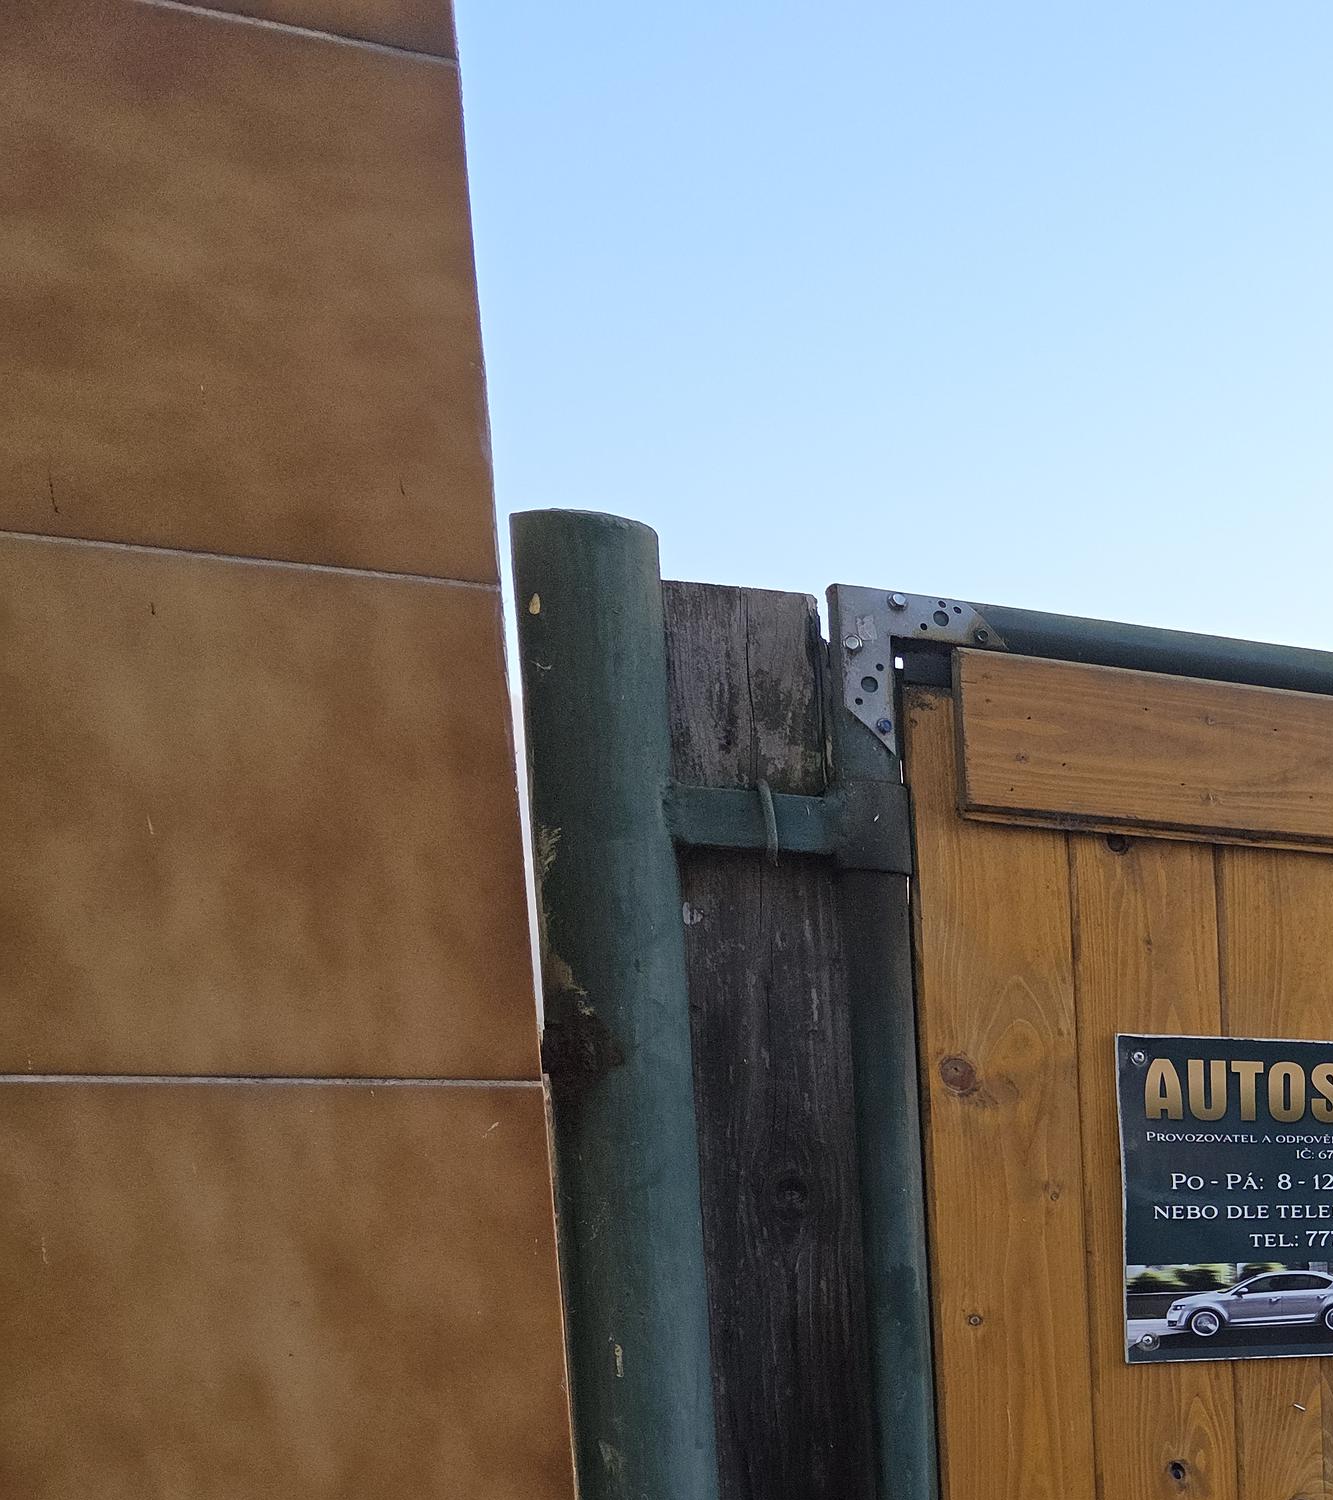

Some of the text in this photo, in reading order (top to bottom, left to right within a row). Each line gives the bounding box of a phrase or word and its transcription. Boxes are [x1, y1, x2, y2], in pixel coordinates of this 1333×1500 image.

[1146, 1131, 1258, 1144] PROVOZOVATEL
[1262, 1135, 1271, 1143] A
[1296, 1147, 1315, 1160] IČ:
[1171, 1173, 1205, 1190] PO
[1226, 1172, 1264, 1190] PÁ:
[1277, 1173, 1292, 1190] 8
[1153, 1204, 1219, 1220] NEBO
[1226, 1205, 1269, 1219] DLE
[1249, 1233, 1299, 1248] TEL.:
